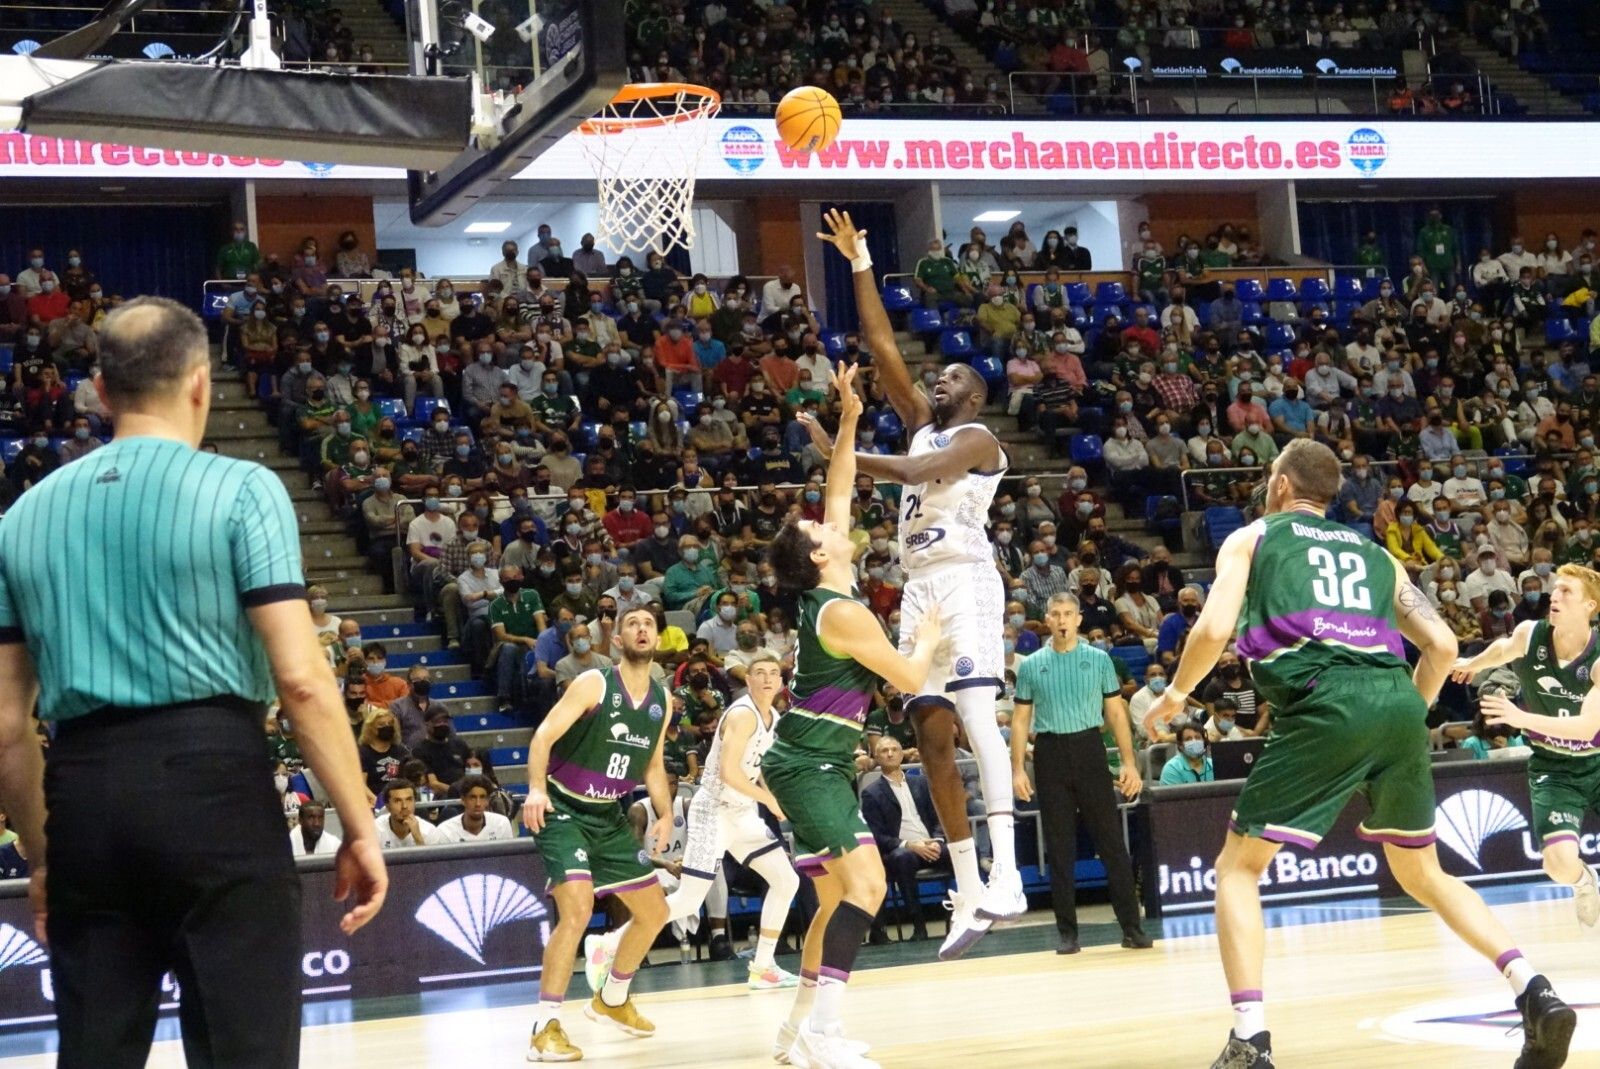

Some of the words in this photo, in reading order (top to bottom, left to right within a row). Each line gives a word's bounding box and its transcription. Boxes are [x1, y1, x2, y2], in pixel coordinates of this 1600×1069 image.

[774, 132, 1341, 169] www.merchanendirecto.es
[1350, 145, 1385, 156] MARCA
[1291, 522, 1362, 546] GUERRERO
[1308, 546, 1371, 610] 32
[625, 733, 650, 746] Unicaja
[606, 752, 631, 780] 83
[1275, 851, 1378, 884] Banco
